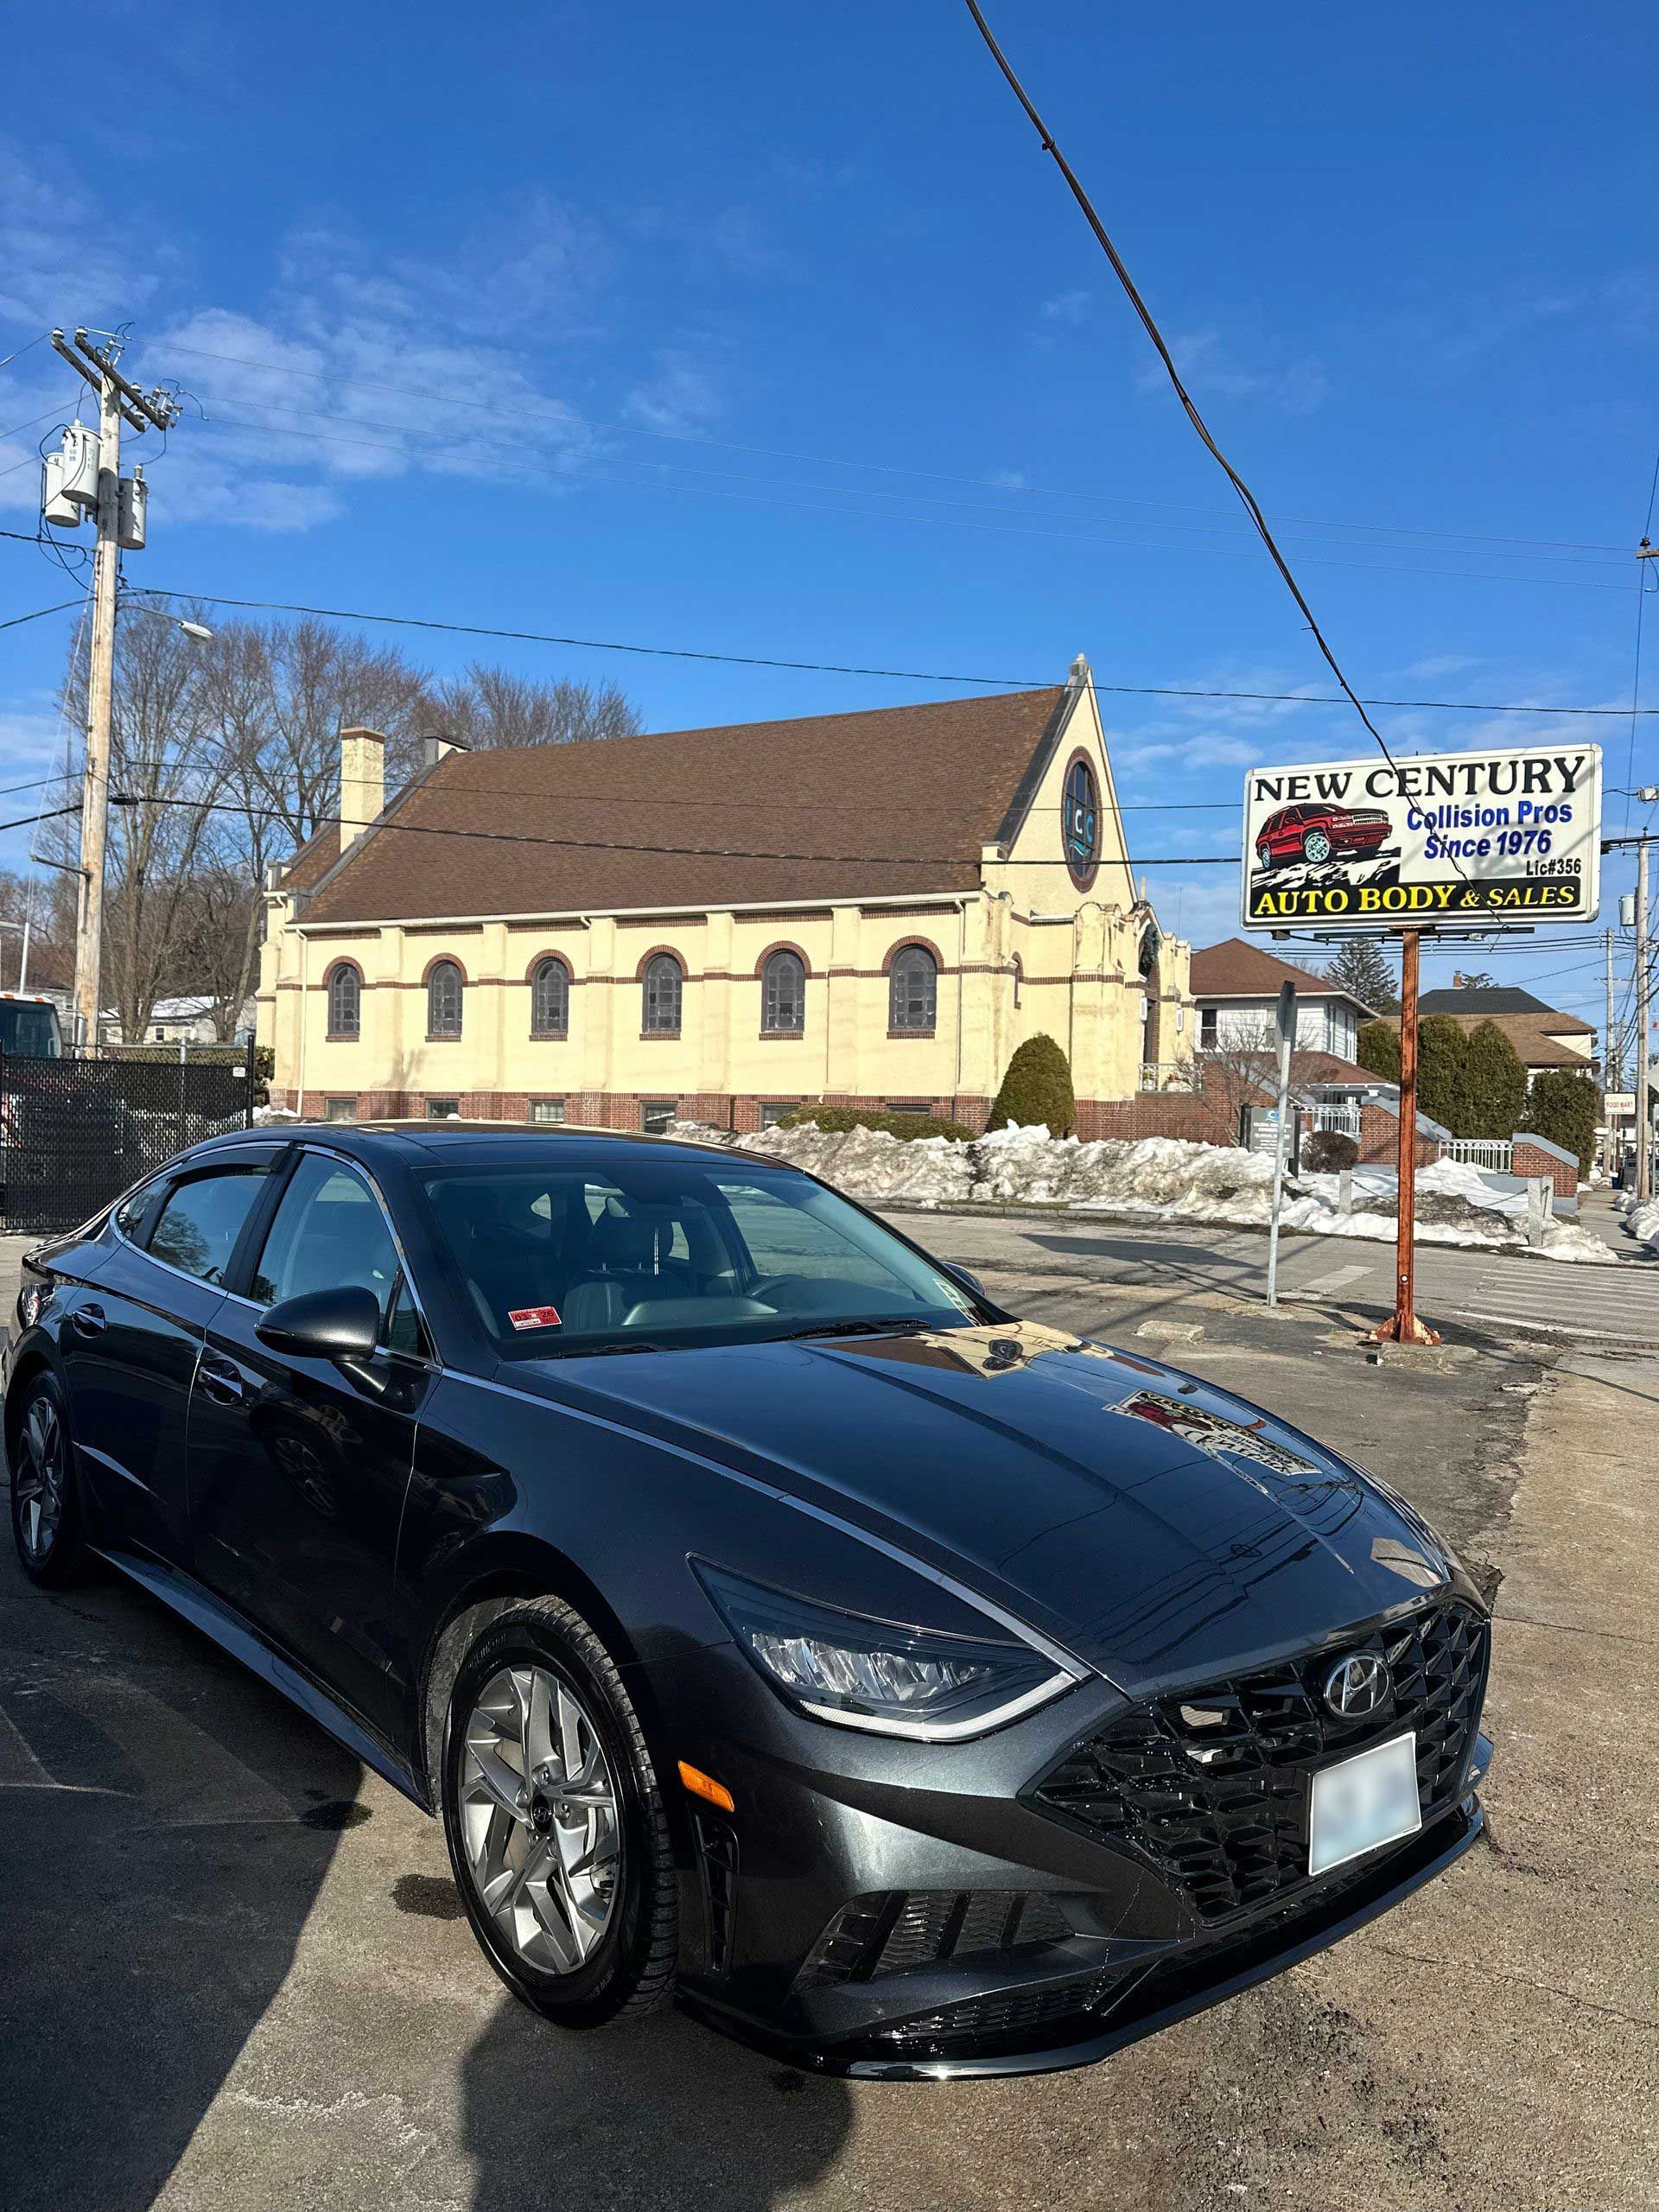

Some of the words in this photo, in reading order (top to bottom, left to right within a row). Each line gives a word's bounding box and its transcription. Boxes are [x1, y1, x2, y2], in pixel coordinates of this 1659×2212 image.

[1255, 772, 1353, 801] NEW
[1365, 756, 1586, 798] CENTURY
[1407, 803, 1510, 830] Collision
[1518, 800, 1573, 825] Pros
[1424, 832, 1491, 859] Since
[1497, 830, 1553, 855] 1976
[1526, 858, 1582, 875] Lic#356
[1254, 889, 1349, 915] AUTO
[1358, 885, 1458, 911] BODY
[1460, 889, 1480, 907] &
[1487, 886, 1575, 906] SALES
